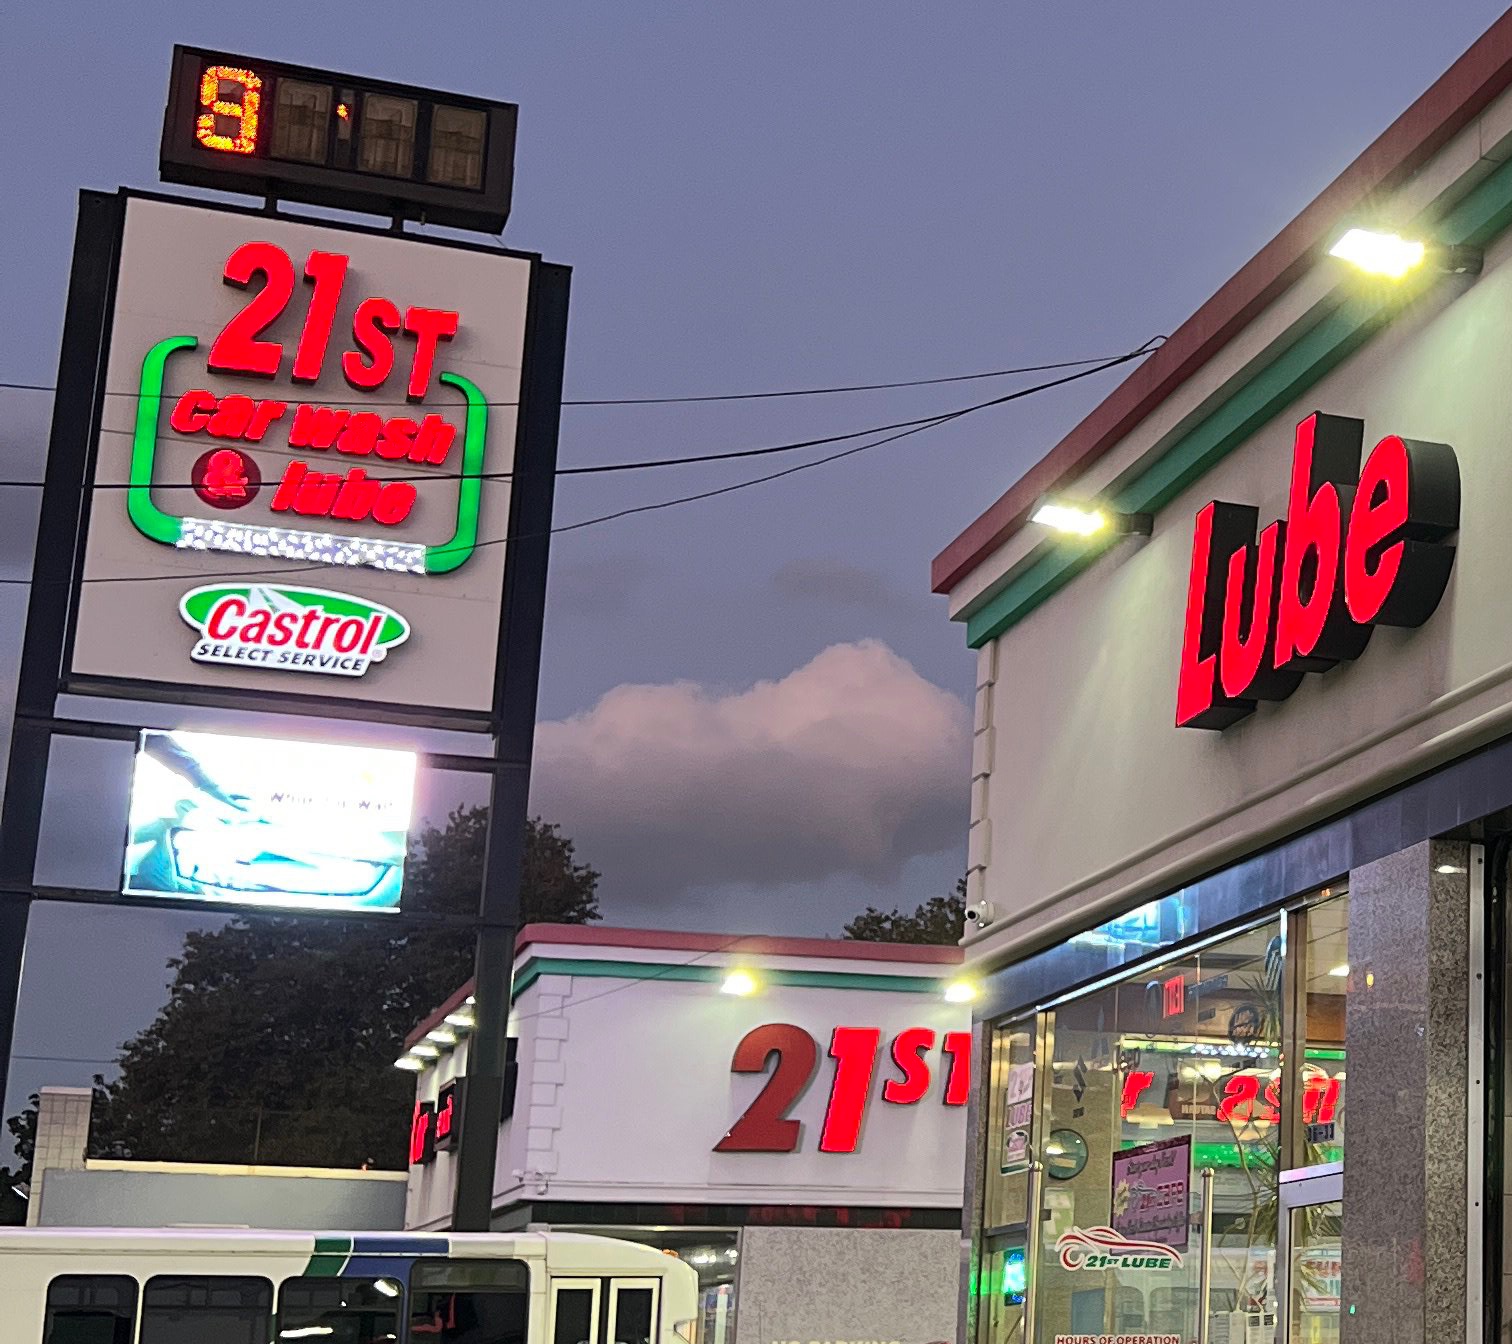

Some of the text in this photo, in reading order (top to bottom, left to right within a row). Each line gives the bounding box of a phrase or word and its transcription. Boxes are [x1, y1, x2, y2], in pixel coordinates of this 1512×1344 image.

[207, 240, 460, 403] 21ST
[170, 389, 458, 466] car wash
[1175, 410, 1412, 728] Lube
[197, 643, 366, 671] SELECT SERVICE
[207, 598, 383, 655] Castrol
[1121, 1257, 1172, 1269] LUBE
